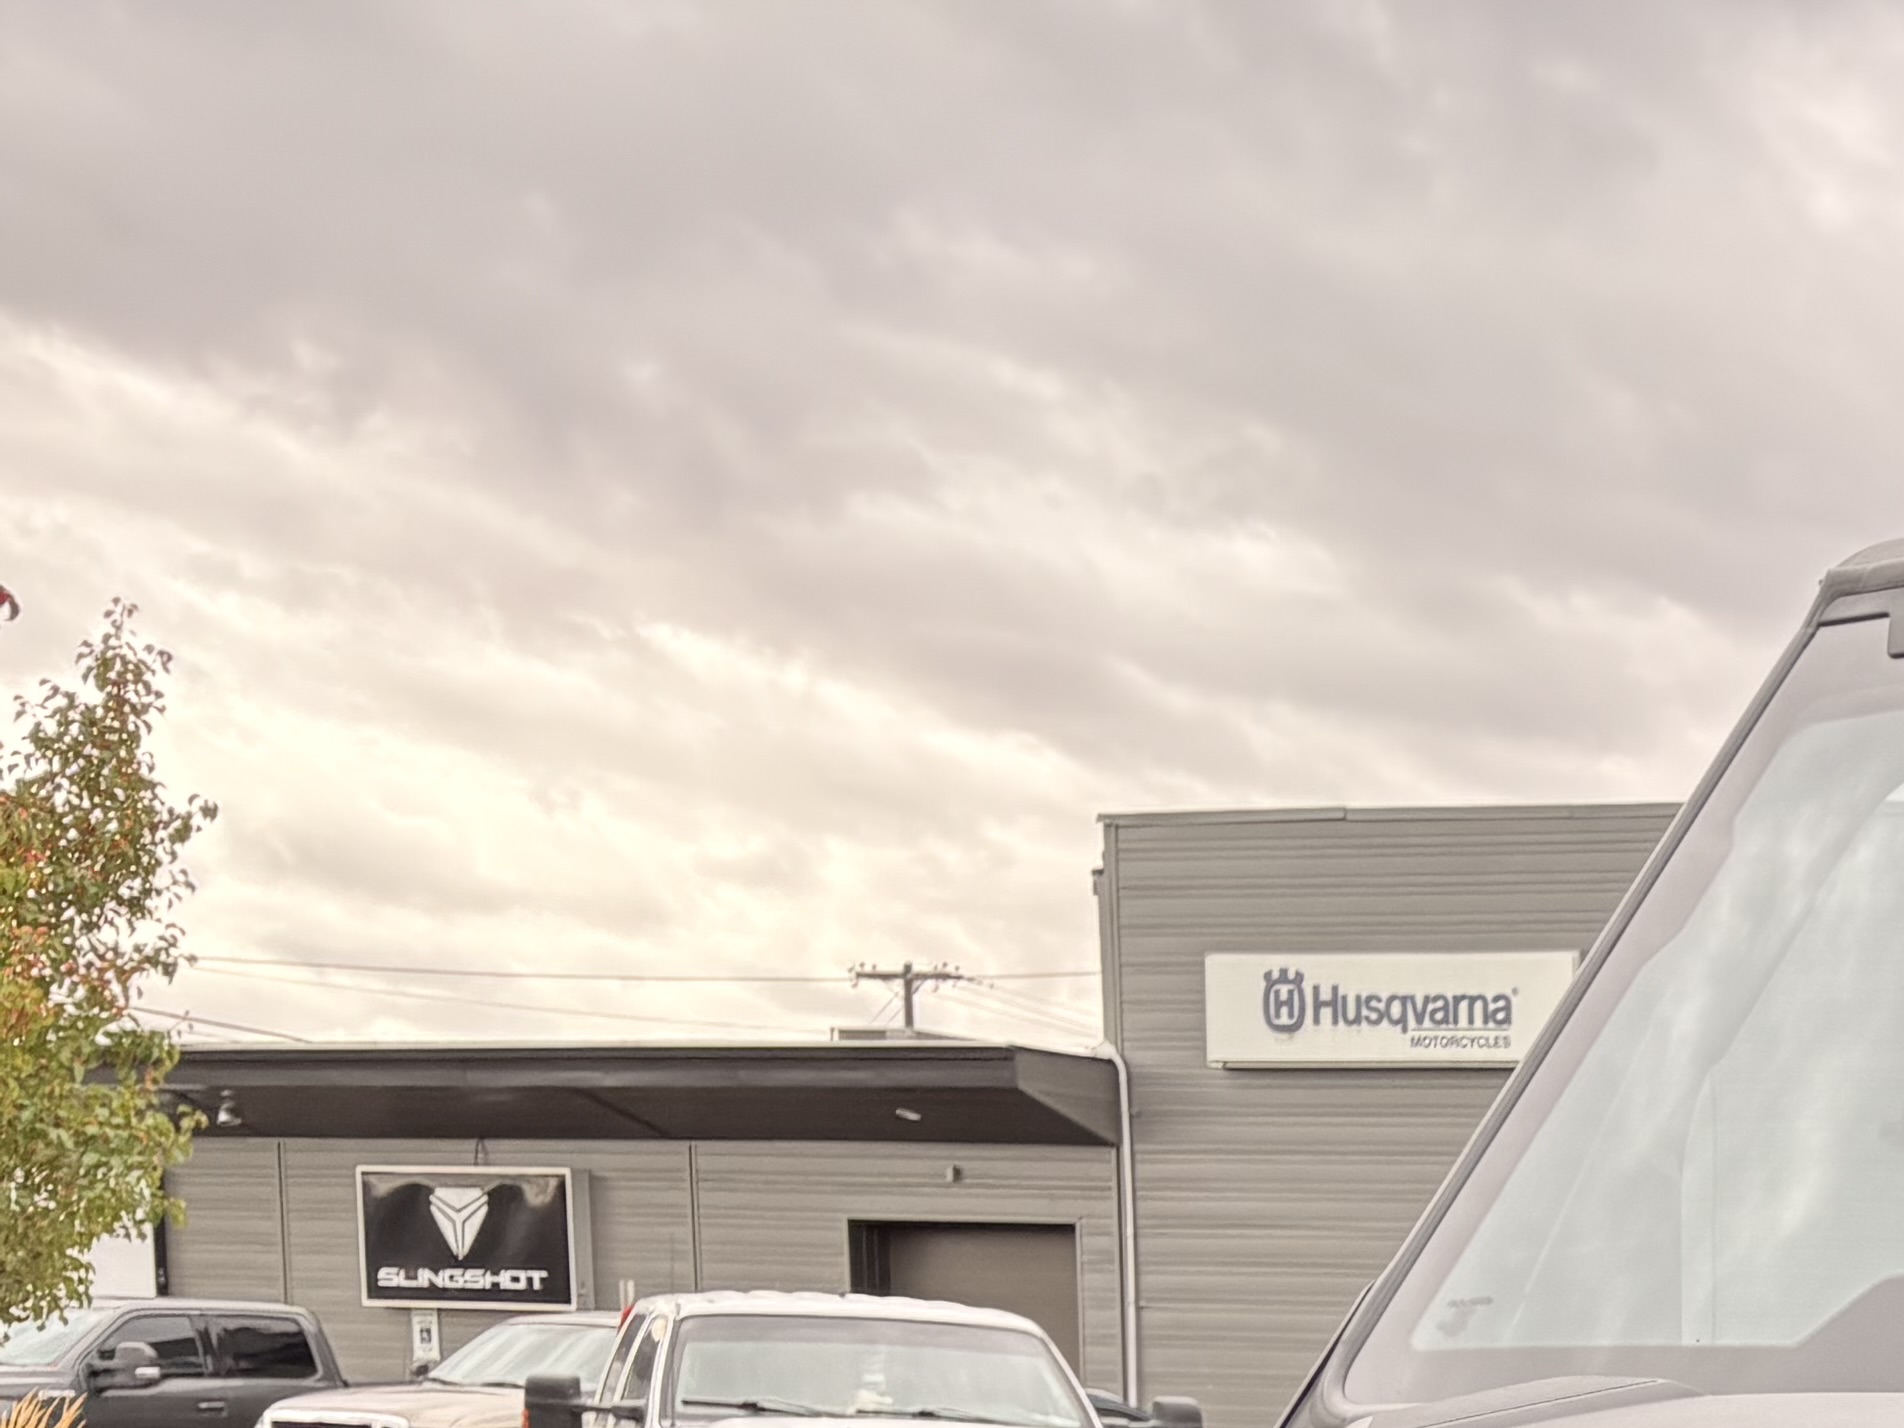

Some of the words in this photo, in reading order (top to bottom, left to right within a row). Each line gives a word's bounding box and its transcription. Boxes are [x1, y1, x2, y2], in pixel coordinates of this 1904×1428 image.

[1312, 984, 1512, 1034] Husqvarna
[1410, 1035, 1511, 1049] MOTORCYCLES
[377, 1267, 549, 1291] SLINGSHOT
